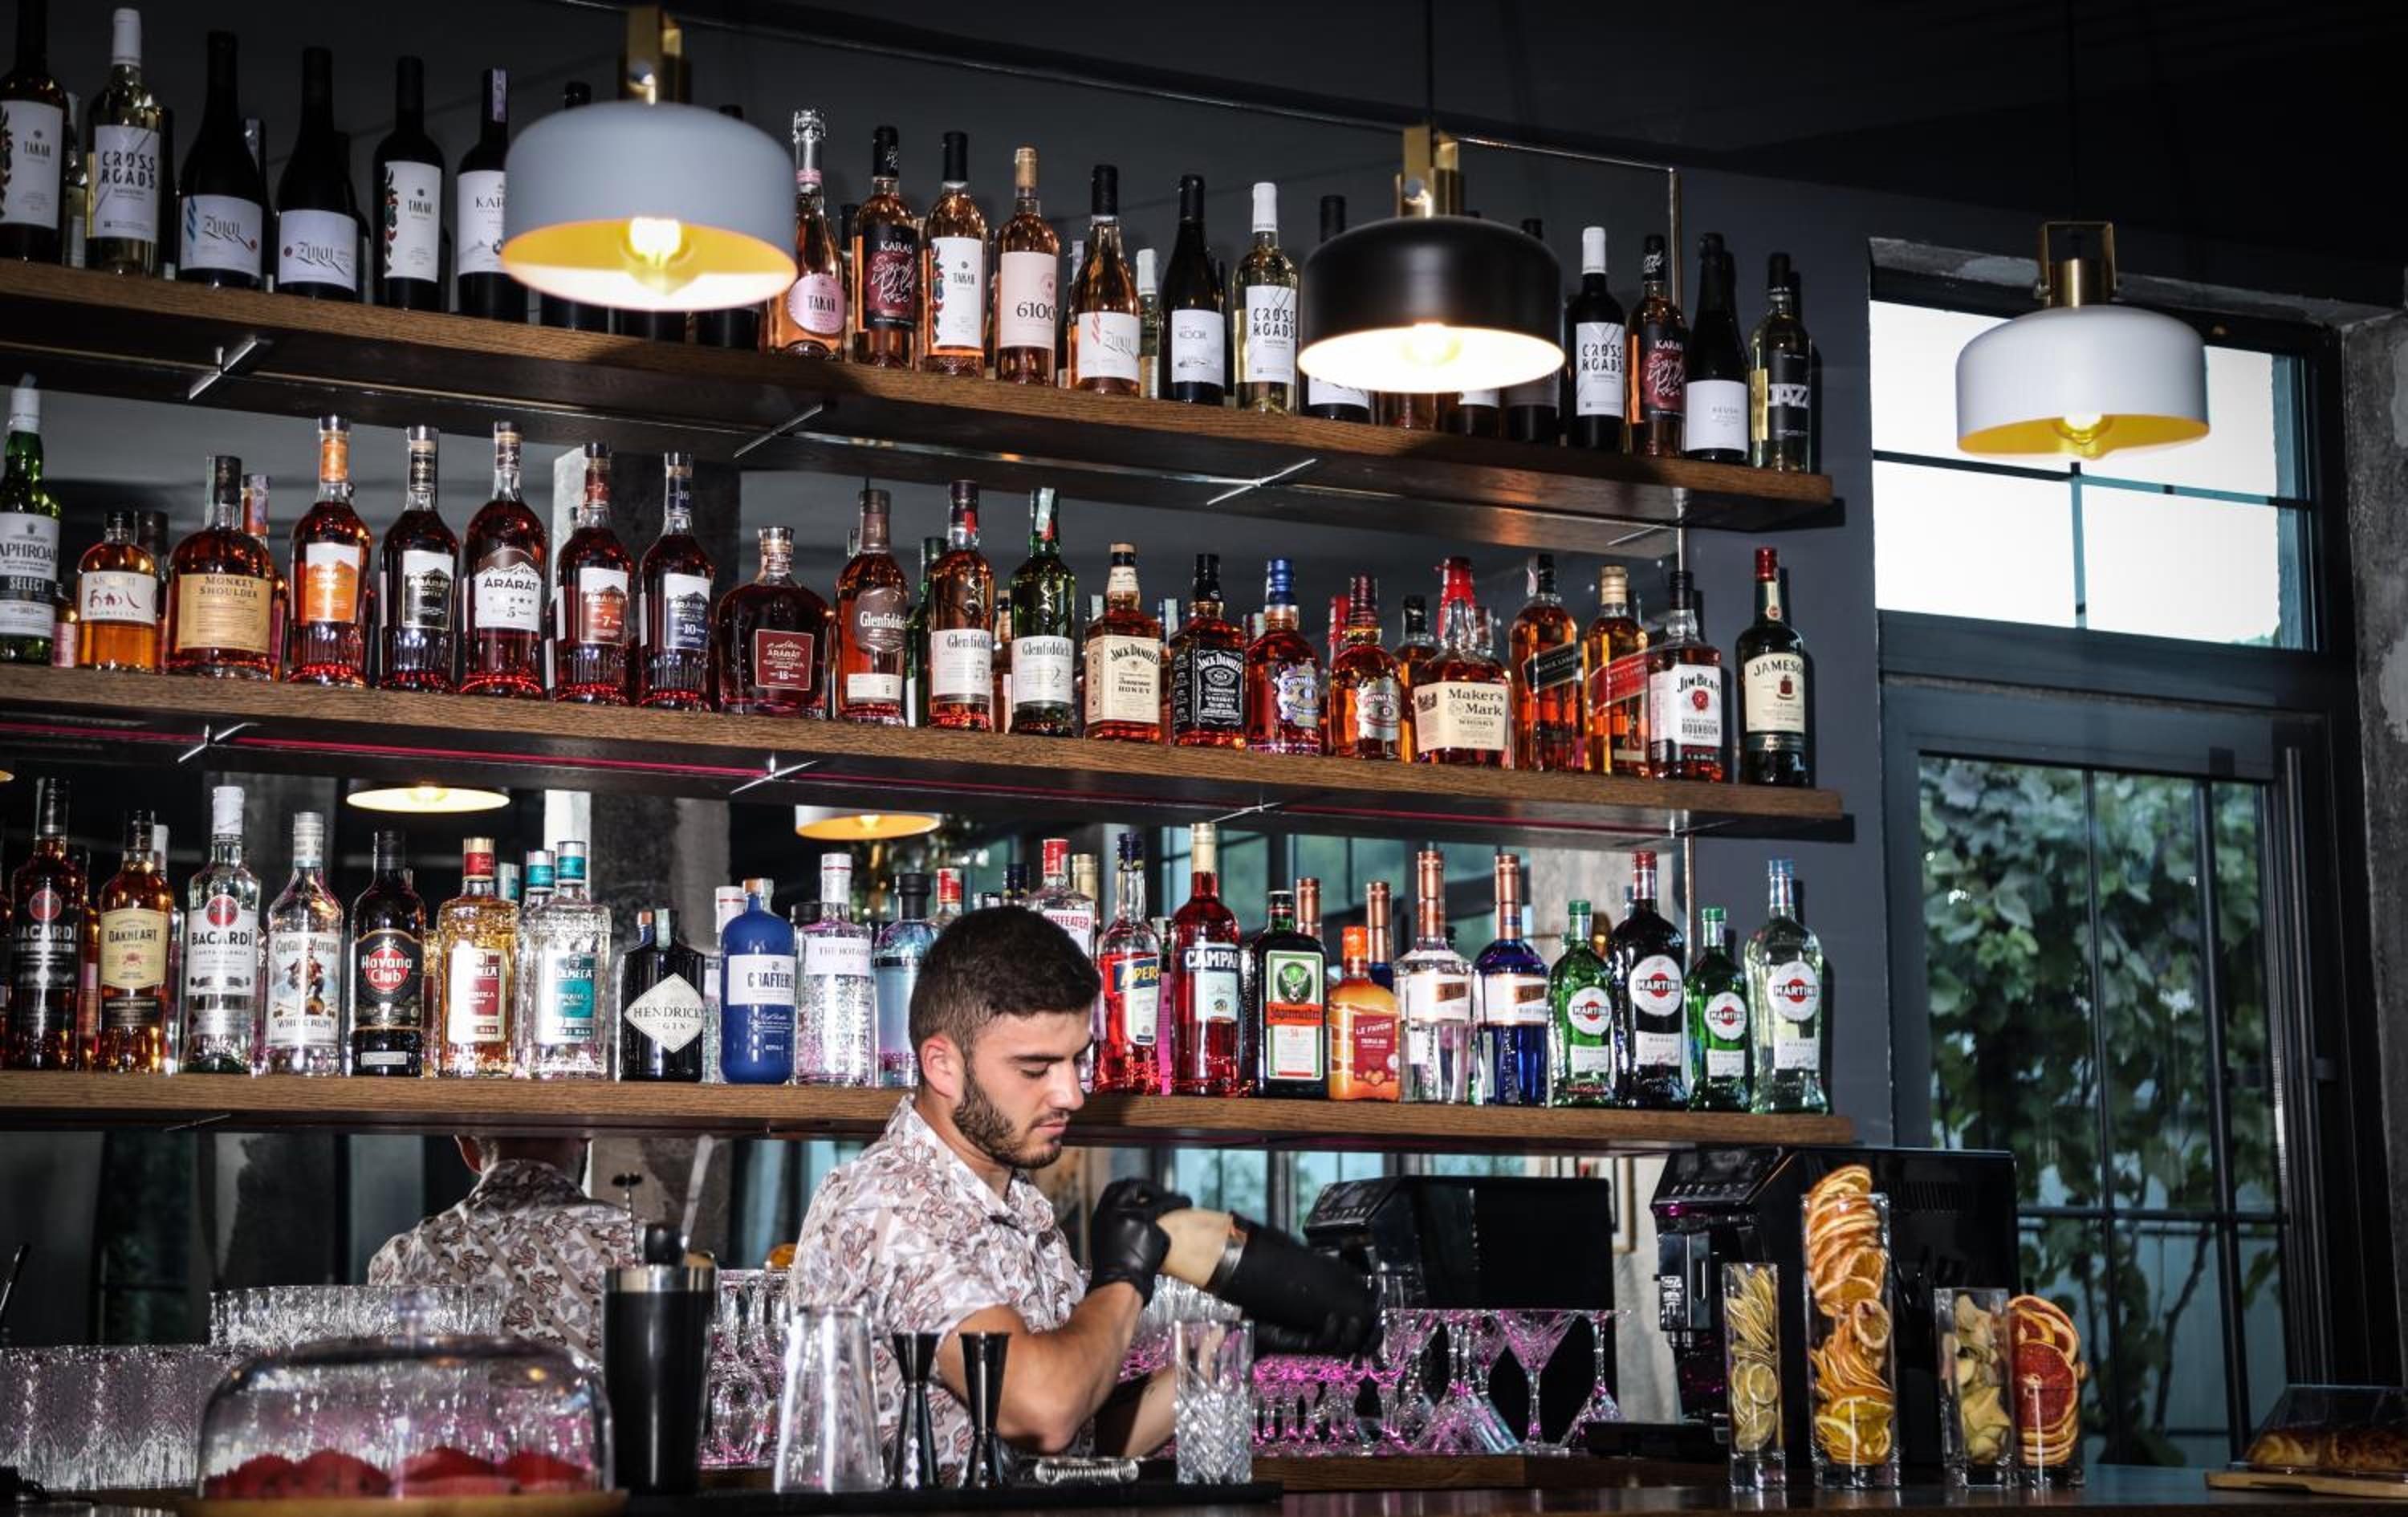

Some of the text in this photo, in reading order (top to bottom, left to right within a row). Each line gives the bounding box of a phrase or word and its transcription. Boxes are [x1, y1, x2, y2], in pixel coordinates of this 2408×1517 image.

[102, 151, 155, 172] CROSS
[101, 169, 155, 189] ROADS
[881, 240, 913, 254] KARAS
[1016, 301, 1055, 321] 6100
[1253, 307, 1295, 324] CROSS
[1253, 323, 1295, 340] ROADS
[1582, 343, 1622, 359] CROSS
[1582, 357, 1622, 373] ROADS
[9, 575, 46, 592] SELECT
[205, 575, 254, 588] MONKEY
[484, 576, 539, 592] ARARAT
[199, 585, 258, 598] SHOULDER
[603, 616, 611, 627] 7
[683, 624, 696, 635] 10
[1110, 645, 1129, 663] JACK
[1197, 655, 1216, 671] JACK
[1677, 675, 1695, 693] JIM
[1465, 703, 1503, 717] Mark
[108, 929, 157, 943] OAKHEART
[361, 954, 413, 970] Havana
[370, 969, 402, 984] Club
[1635, 978, 1680, 992] MARTINI
[1773, 984, 1818, 998] MARTINI
[1572, 1005, 1609, 1016] MARTINI
[1709, 1011, 1746, 1022] MARTINI
[662, 1022, 687, 1030] GIN
[1356, 1027, 1365, 1035] LE
